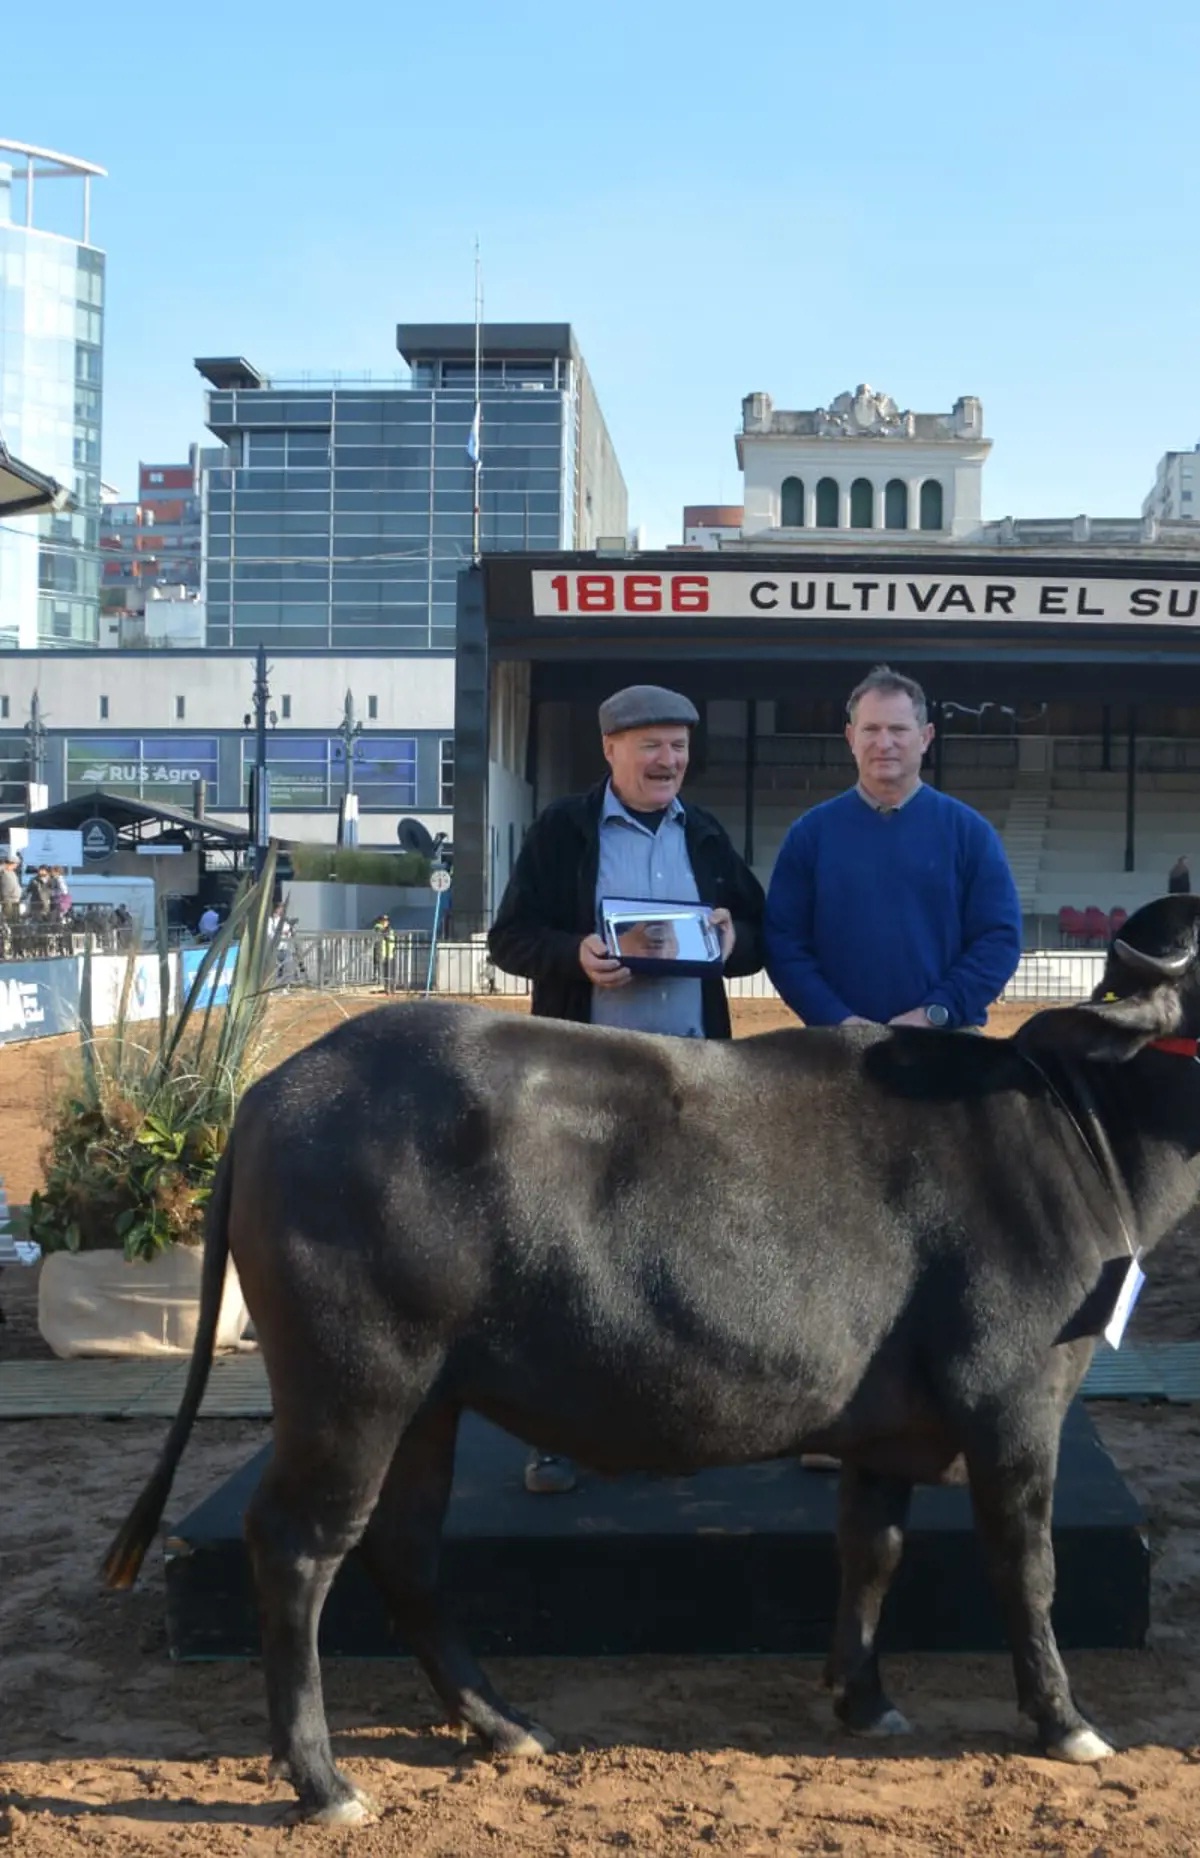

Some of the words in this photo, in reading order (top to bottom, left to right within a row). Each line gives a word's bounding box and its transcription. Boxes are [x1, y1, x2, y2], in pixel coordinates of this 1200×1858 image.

[551, 575, 709, 613] 1866
[749, 581, 1017, 614] CULTIVAR
[1038, 585, 1105, 616] EL
[109, 765, 149, 781] RUS
[154, 765, 200, 784] Agro
